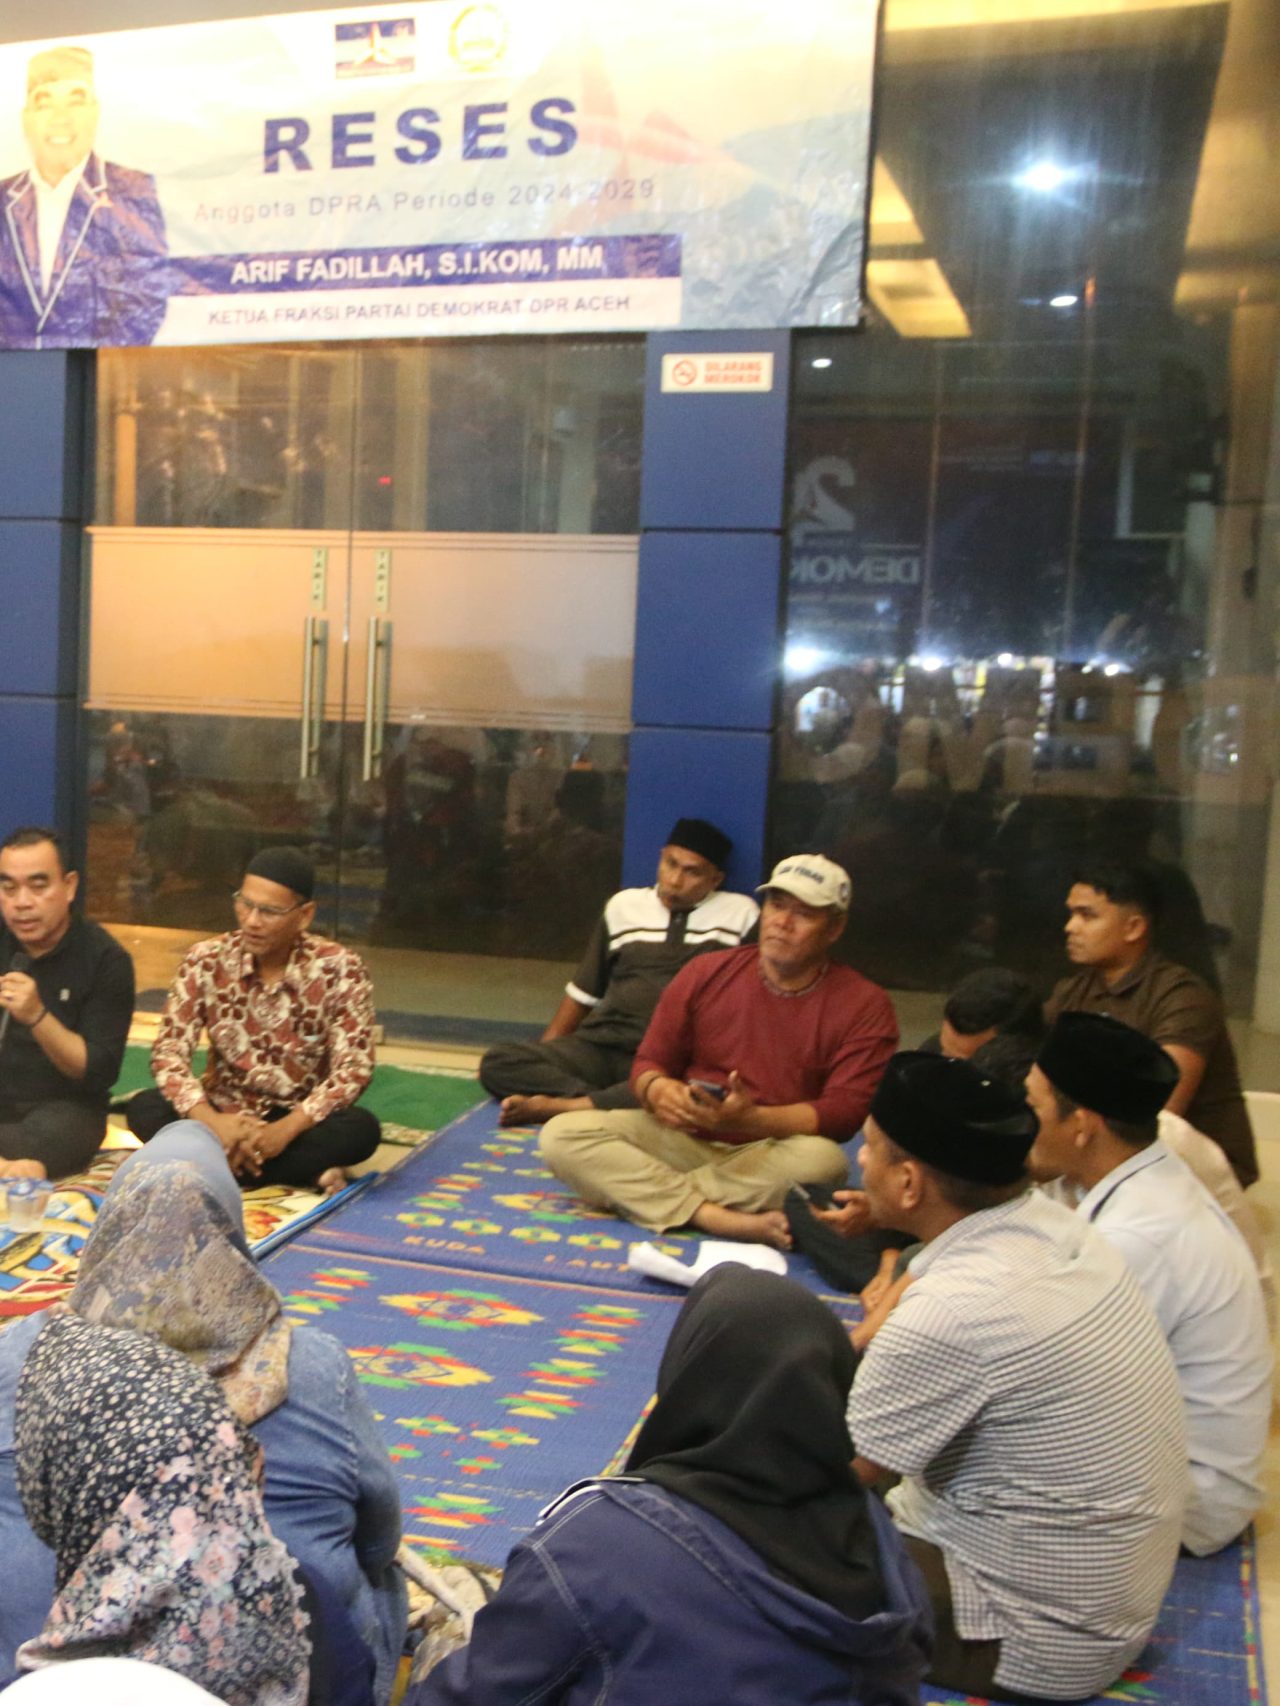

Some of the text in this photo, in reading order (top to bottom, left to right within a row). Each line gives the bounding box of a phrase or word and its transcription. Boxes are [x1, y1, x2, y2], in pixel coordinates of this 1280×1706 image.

[263, 97, 578, 173] RESES
[194, 203, 296, 224] Anggota
[309, 194, 382, 216] DPRA
[394, 187, 495, 211] Periode
[231, 245, 604, 285] ARIF FADILLAH, S.I.KOM, MM
[208, 296, 630, 325] KETUA FRAKSI PARTAI DEMOKRAT DPR ACEH
[403, 1236, 485, 1255] KUDA
